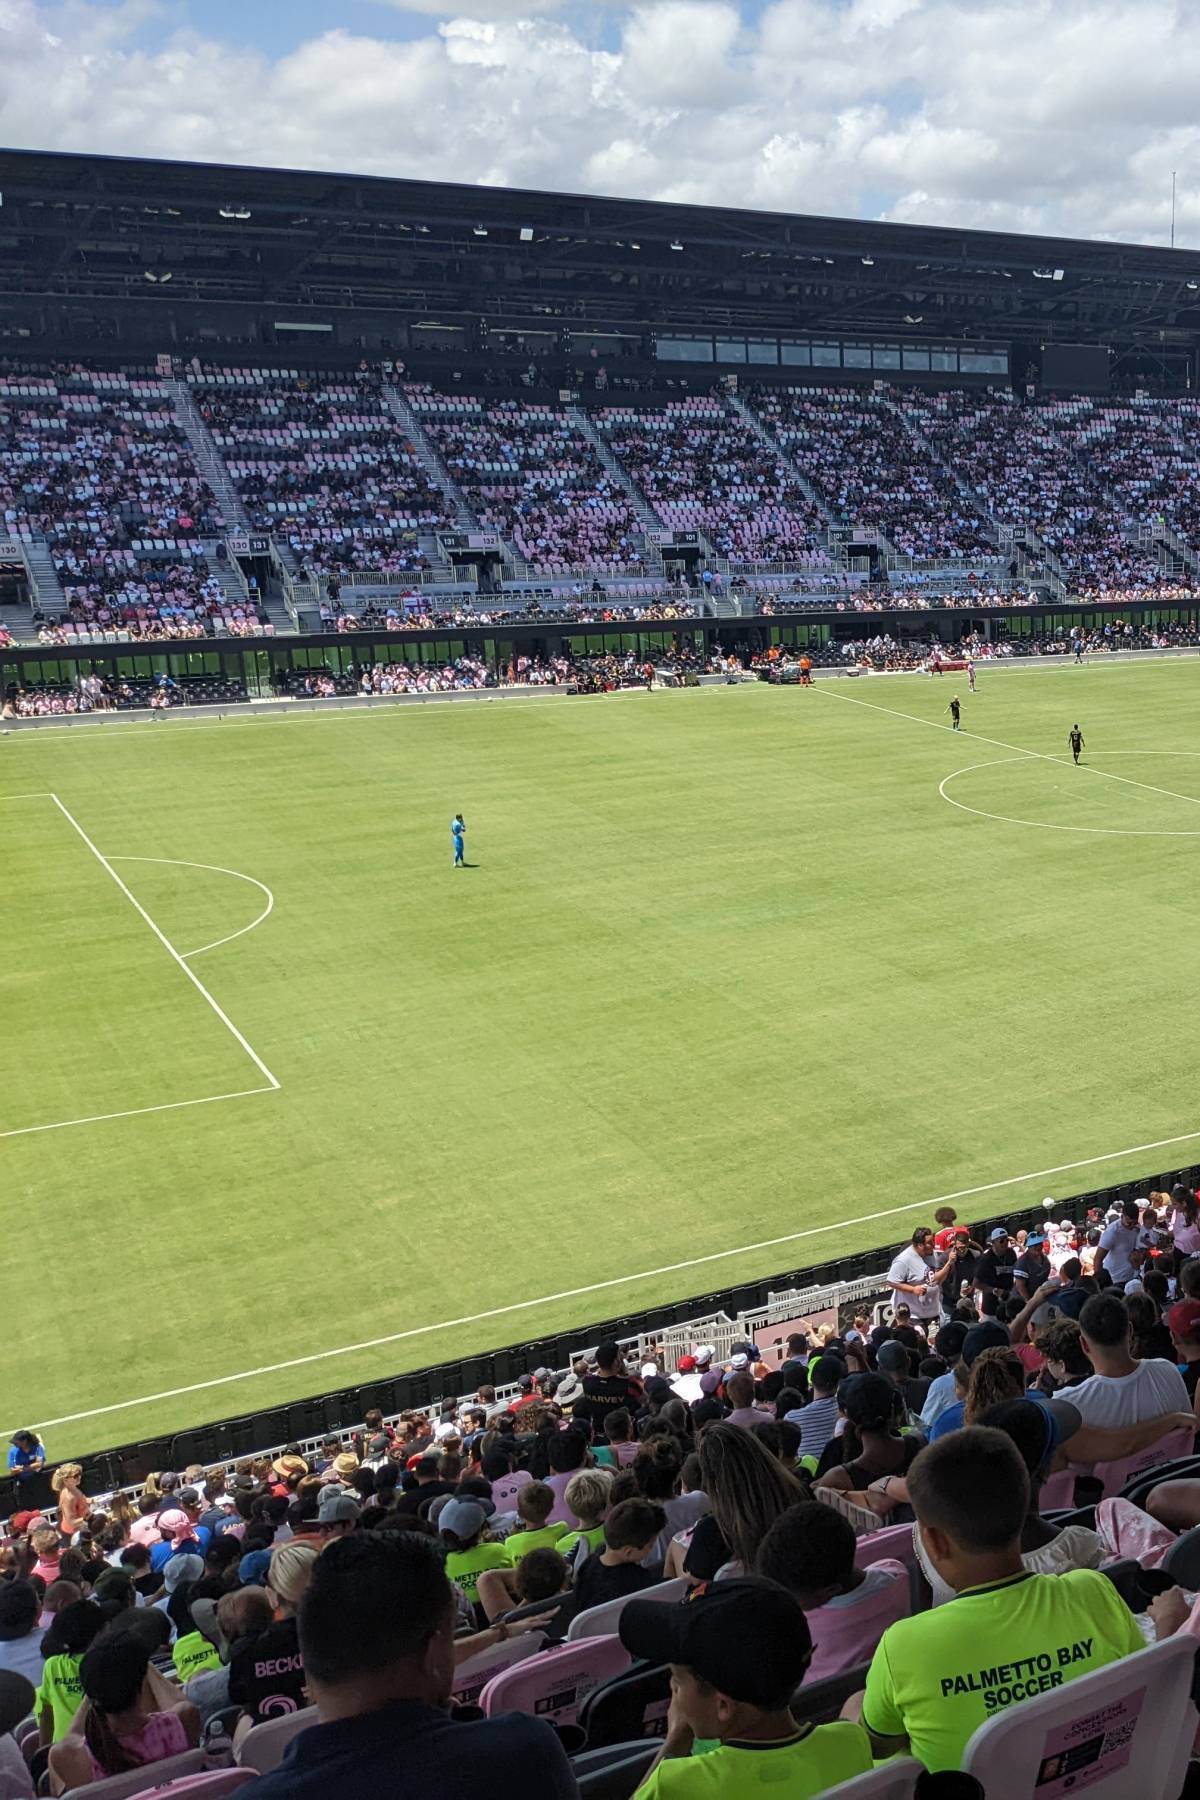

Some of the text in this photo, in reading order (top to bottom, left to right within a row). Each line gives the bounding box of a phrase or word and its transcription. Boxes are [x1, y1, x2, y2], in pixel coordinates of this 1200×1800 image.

[1, 546, 17, 554] 130
[940, 1637, 1095, 1697] PALMETTO BAY
[983, 1670, 1064, 1709] SOCCER
